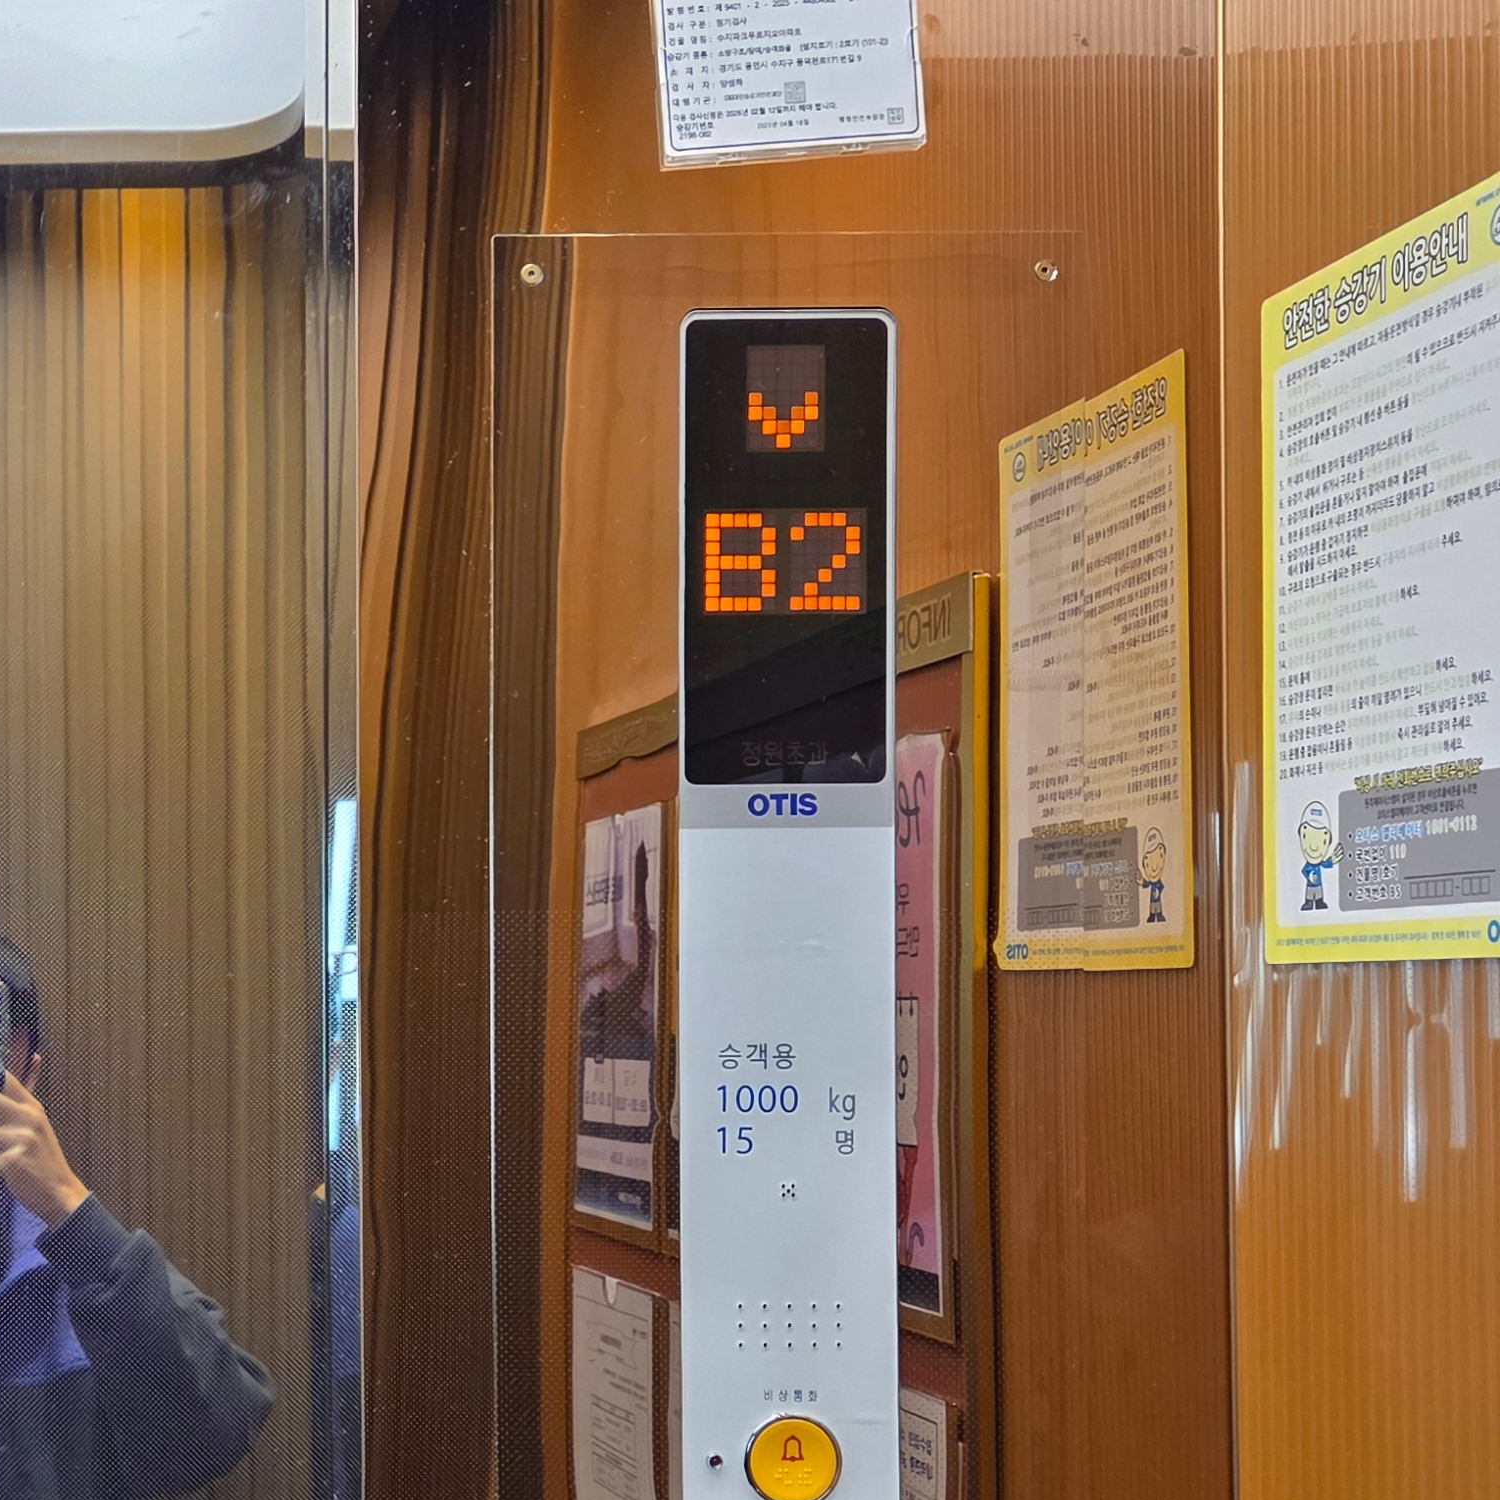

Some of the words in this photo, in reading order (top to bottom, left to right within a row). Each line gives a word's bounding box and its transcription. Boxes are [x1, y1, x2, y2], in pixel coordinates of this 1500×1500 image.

[668, 22, 684, 31] 검사
[716, 17, 747, 27] 정기검사
[719, 63, 742, 73] 경기도
[745, 61, 768, 71] 용인시
[770, 59, 794, 69] 수지구
[673, 113, 687, 122] 다음
[676, 122, 715, 133] 승강기번호
[679, 131, 712, 140] 2198-082
[1282, 285, 1331, 350] 안전한
[1333, 255, 1386, 324] 승강기
[1392, 212, 1469, 292] 이용안내
[1421, 305, 1434, 325] 경우
[705, 512, 861, 612] B2
[1403, 683, 1421, 700] 있으니
[1411, 720, 1436, 739] 관리실로
[741, 739, 829, 767] 정원초과
[747, 793, 818, 817] OTIS
[1355, 827, 1380, 844] 오티스
[1382, 819, 1423, 842] 엘리베이터
[1355, 846, 1387, 864] 국번없이
[1355, 885, 1389, 901] 고객번호
[718, 1043, 797, 1069] 승객용
[717, 1085, 798, 1113] 1000
[828, 1086, 856, 1120] kg
[717, 1126, 753, 1154] 15
[835, 1129, 854, 1155] 명
